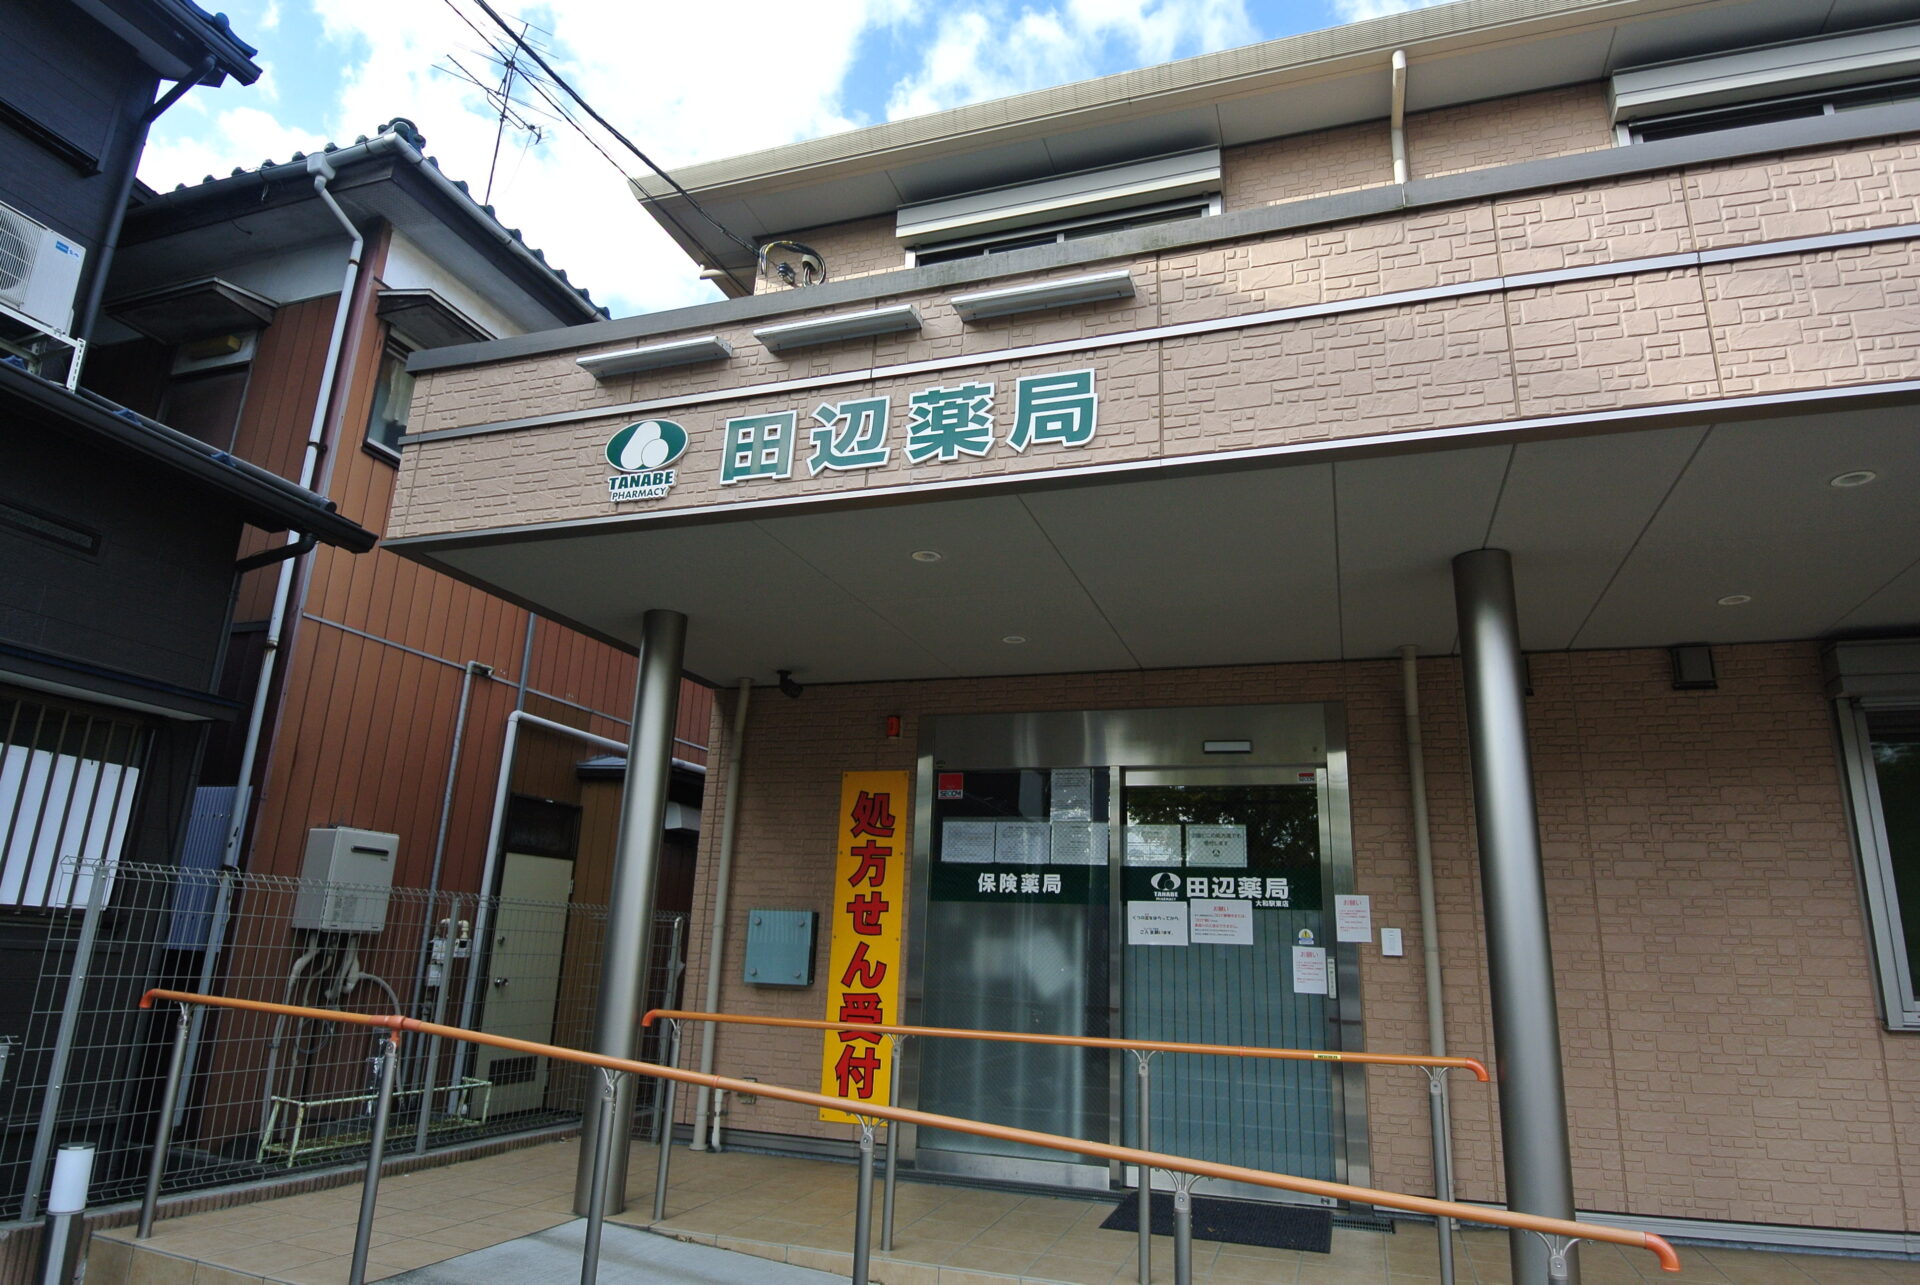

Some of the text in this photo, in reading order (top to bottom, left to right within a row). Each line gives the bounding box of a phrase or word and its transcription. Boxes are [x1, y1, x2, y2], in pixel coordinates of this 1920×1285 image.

[719, 368, 1098, 485] 田辺薬局
[608, 470, 675, 491] TANABE
[611, 486, 667, 500] PHARMACY
[977, 872, 1062, 894] 保険薬局
[1186, 876, 1290, 900] 田辺薬局
[835, 791, 896, 1099] 処方せん受付
